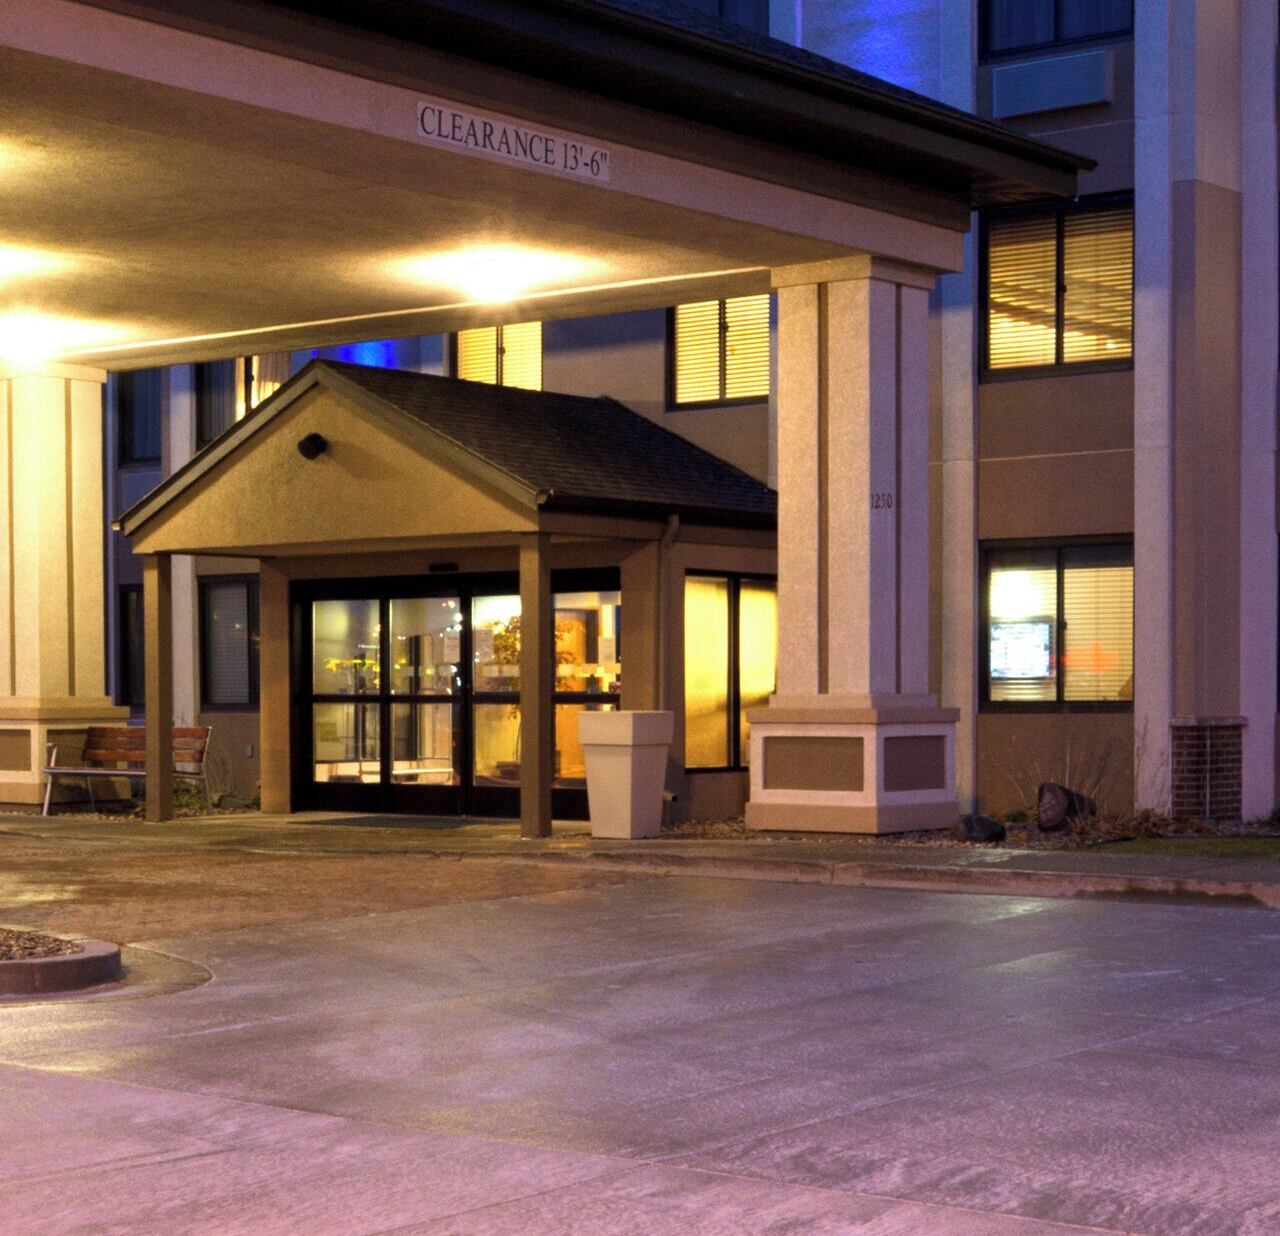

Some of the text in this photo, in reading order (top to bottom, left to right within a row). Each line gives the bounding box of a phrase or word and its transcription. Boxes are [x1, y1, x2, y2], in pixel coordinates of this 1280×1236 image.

[420, 106, 608, 176] CLEARANCE 13'-6"
[870, 492, 893, 509] 1250
